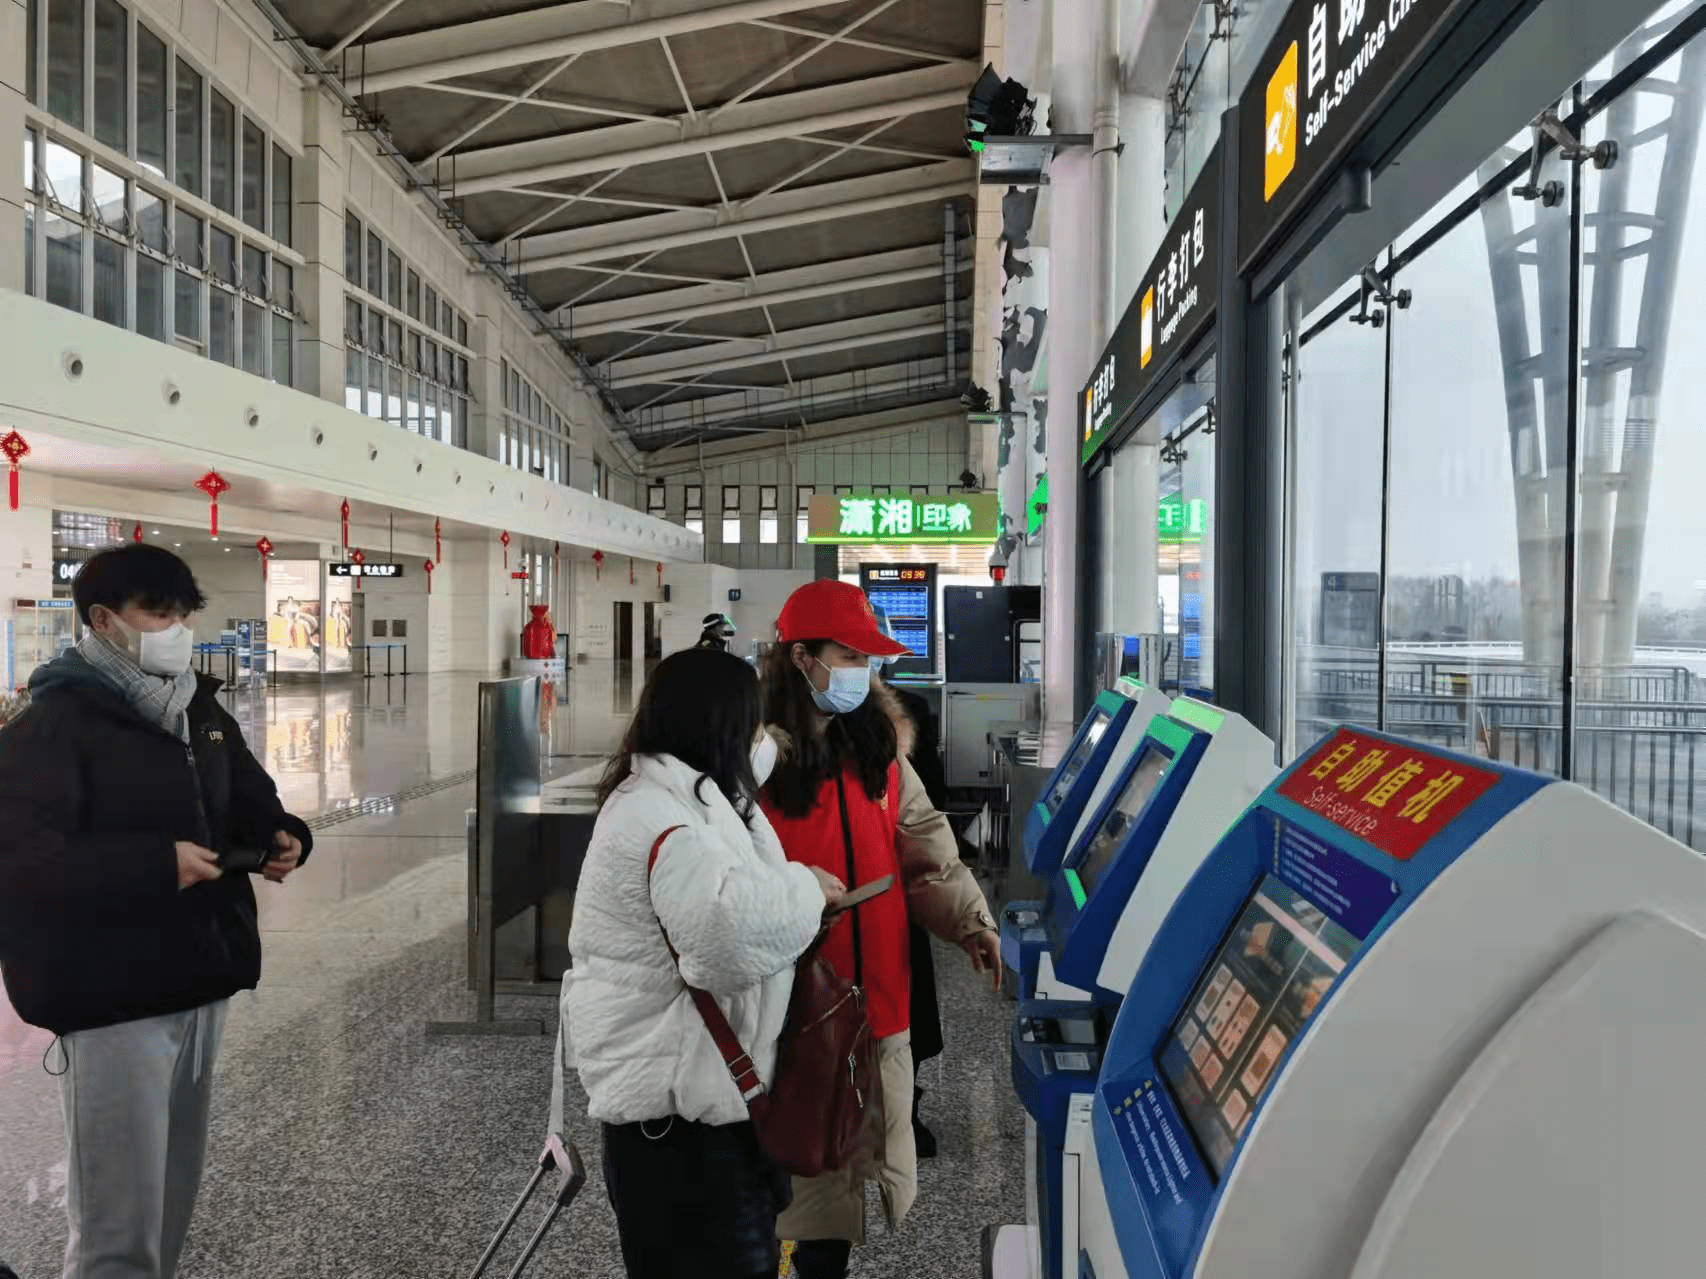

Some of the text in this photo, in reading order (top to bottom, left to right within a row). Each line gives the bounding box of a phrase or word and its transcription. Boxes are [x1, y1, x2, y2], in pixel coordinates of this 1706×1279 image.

[1305, 20, 1386, 146] Self-Service
[1157, 208, 1204, 322] 行李打包
[1307, 739, 1465, 824] 自助值机
